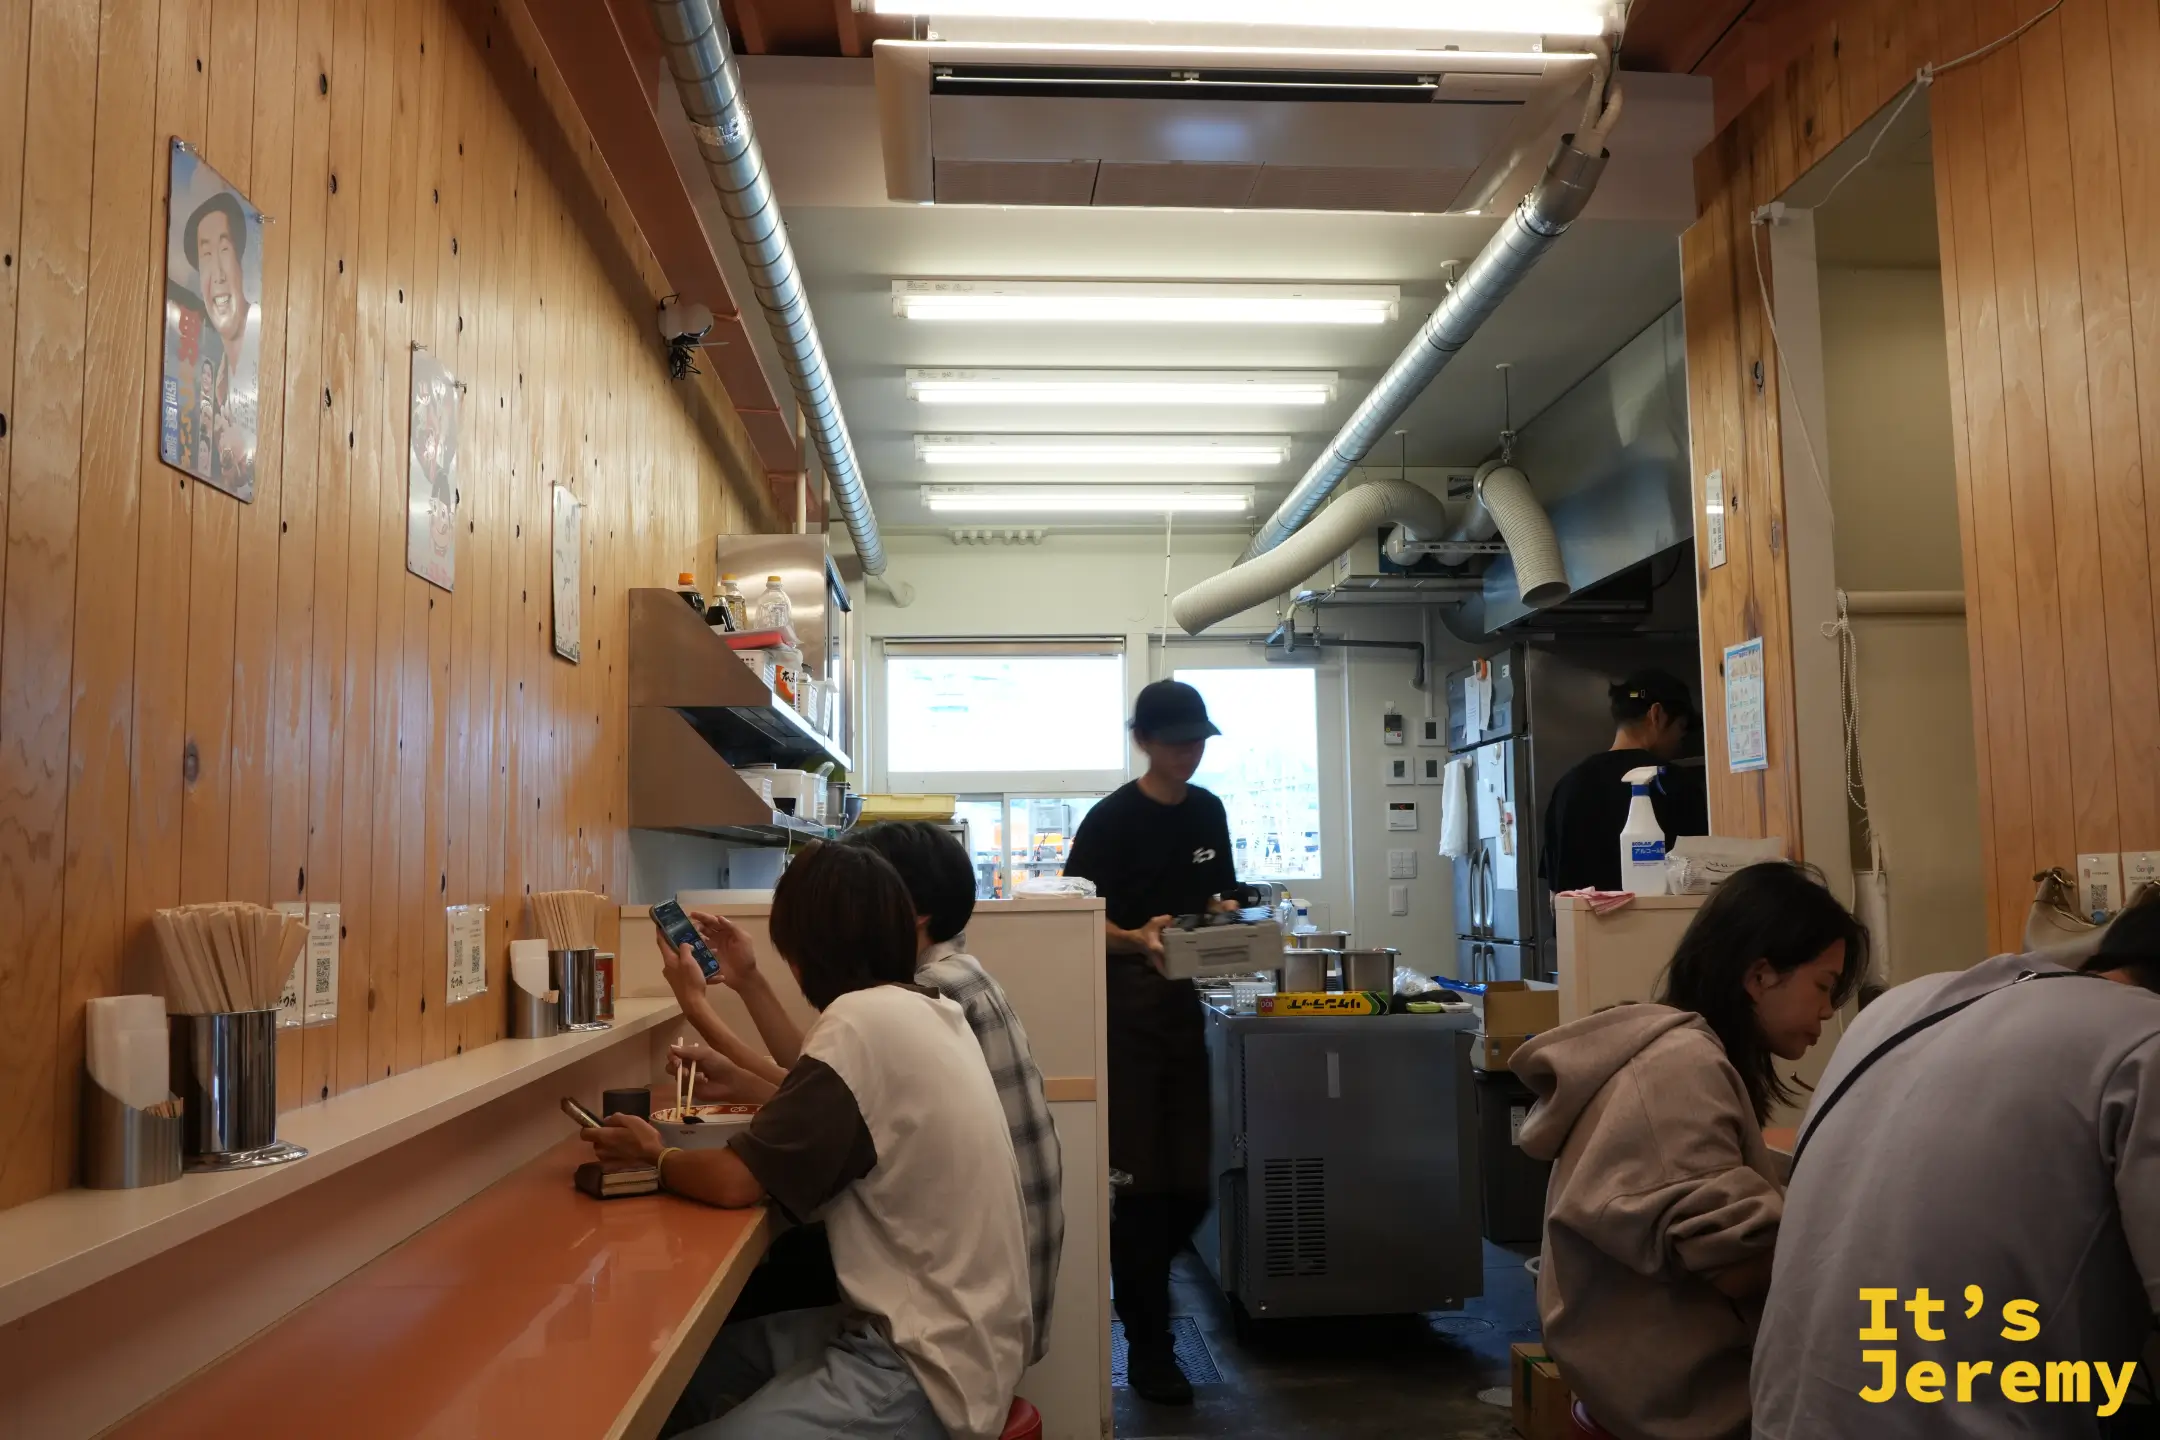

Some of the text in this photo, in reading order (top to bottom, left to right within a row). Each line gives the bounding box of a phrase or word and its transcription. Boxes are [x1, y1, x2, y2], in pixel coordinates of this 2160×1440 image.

[1287, 998, 1361, 1009] リケンラップ
